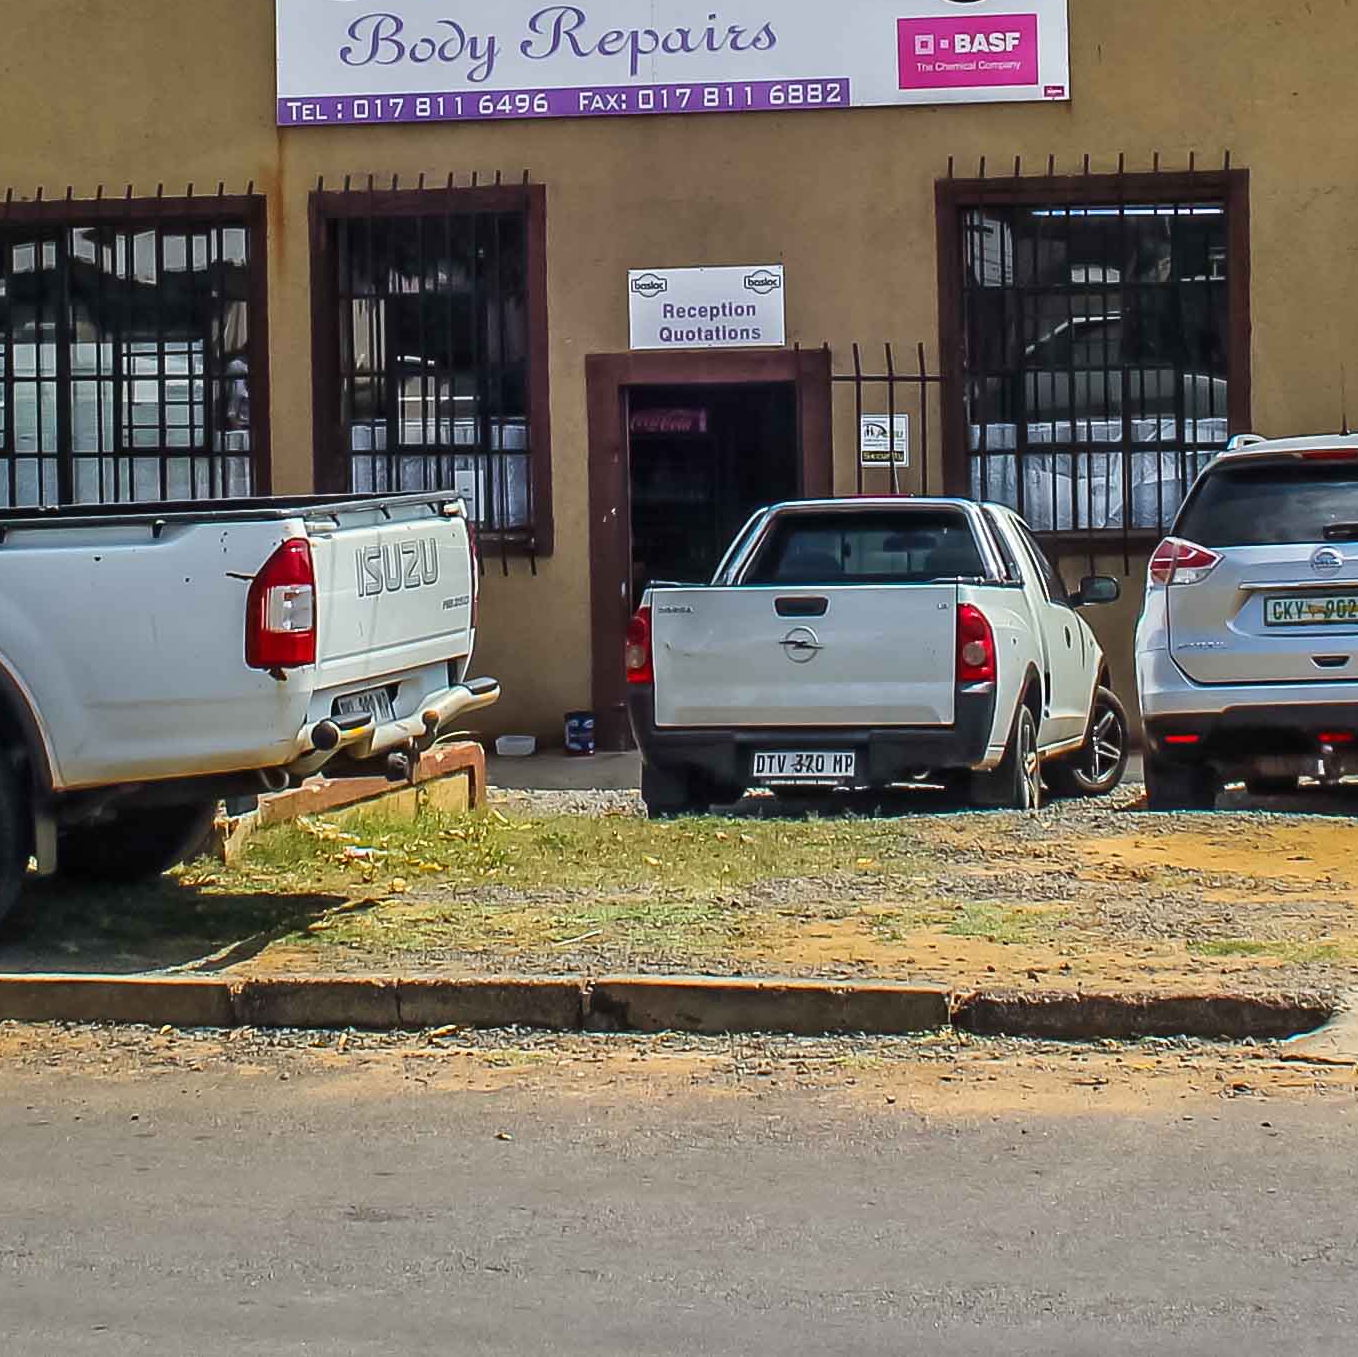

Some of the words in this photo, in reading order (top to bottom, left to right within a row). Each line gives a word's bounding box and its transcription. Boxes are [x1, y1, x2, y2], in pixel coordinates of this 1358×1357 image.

[339, 12, 500, 83] Body
[519, 5, 777, 76] Repairs
[954, 32, 1020, 54] BASF
[916, 62, 933, 73] The
[935, 61, 977, 72] Chemical
[978, 60, 1021, 71] Company
[353, 98, 404, 119] 017
[416, 97, 464, 117] 811
[479, 95, 548, 115] 6496
[638, 88, 693, 109] 017
[703, 86, 753, 107] 811
[769, 83, 842, 105] 6882
[663, 302, 756, 321] Reception
[659, 325, 761, 342] Quotations
[355, 538, 439, 597] ISUZU
[756, 754, 786, 774] DTV
[833, 754, 853, 773] MP
